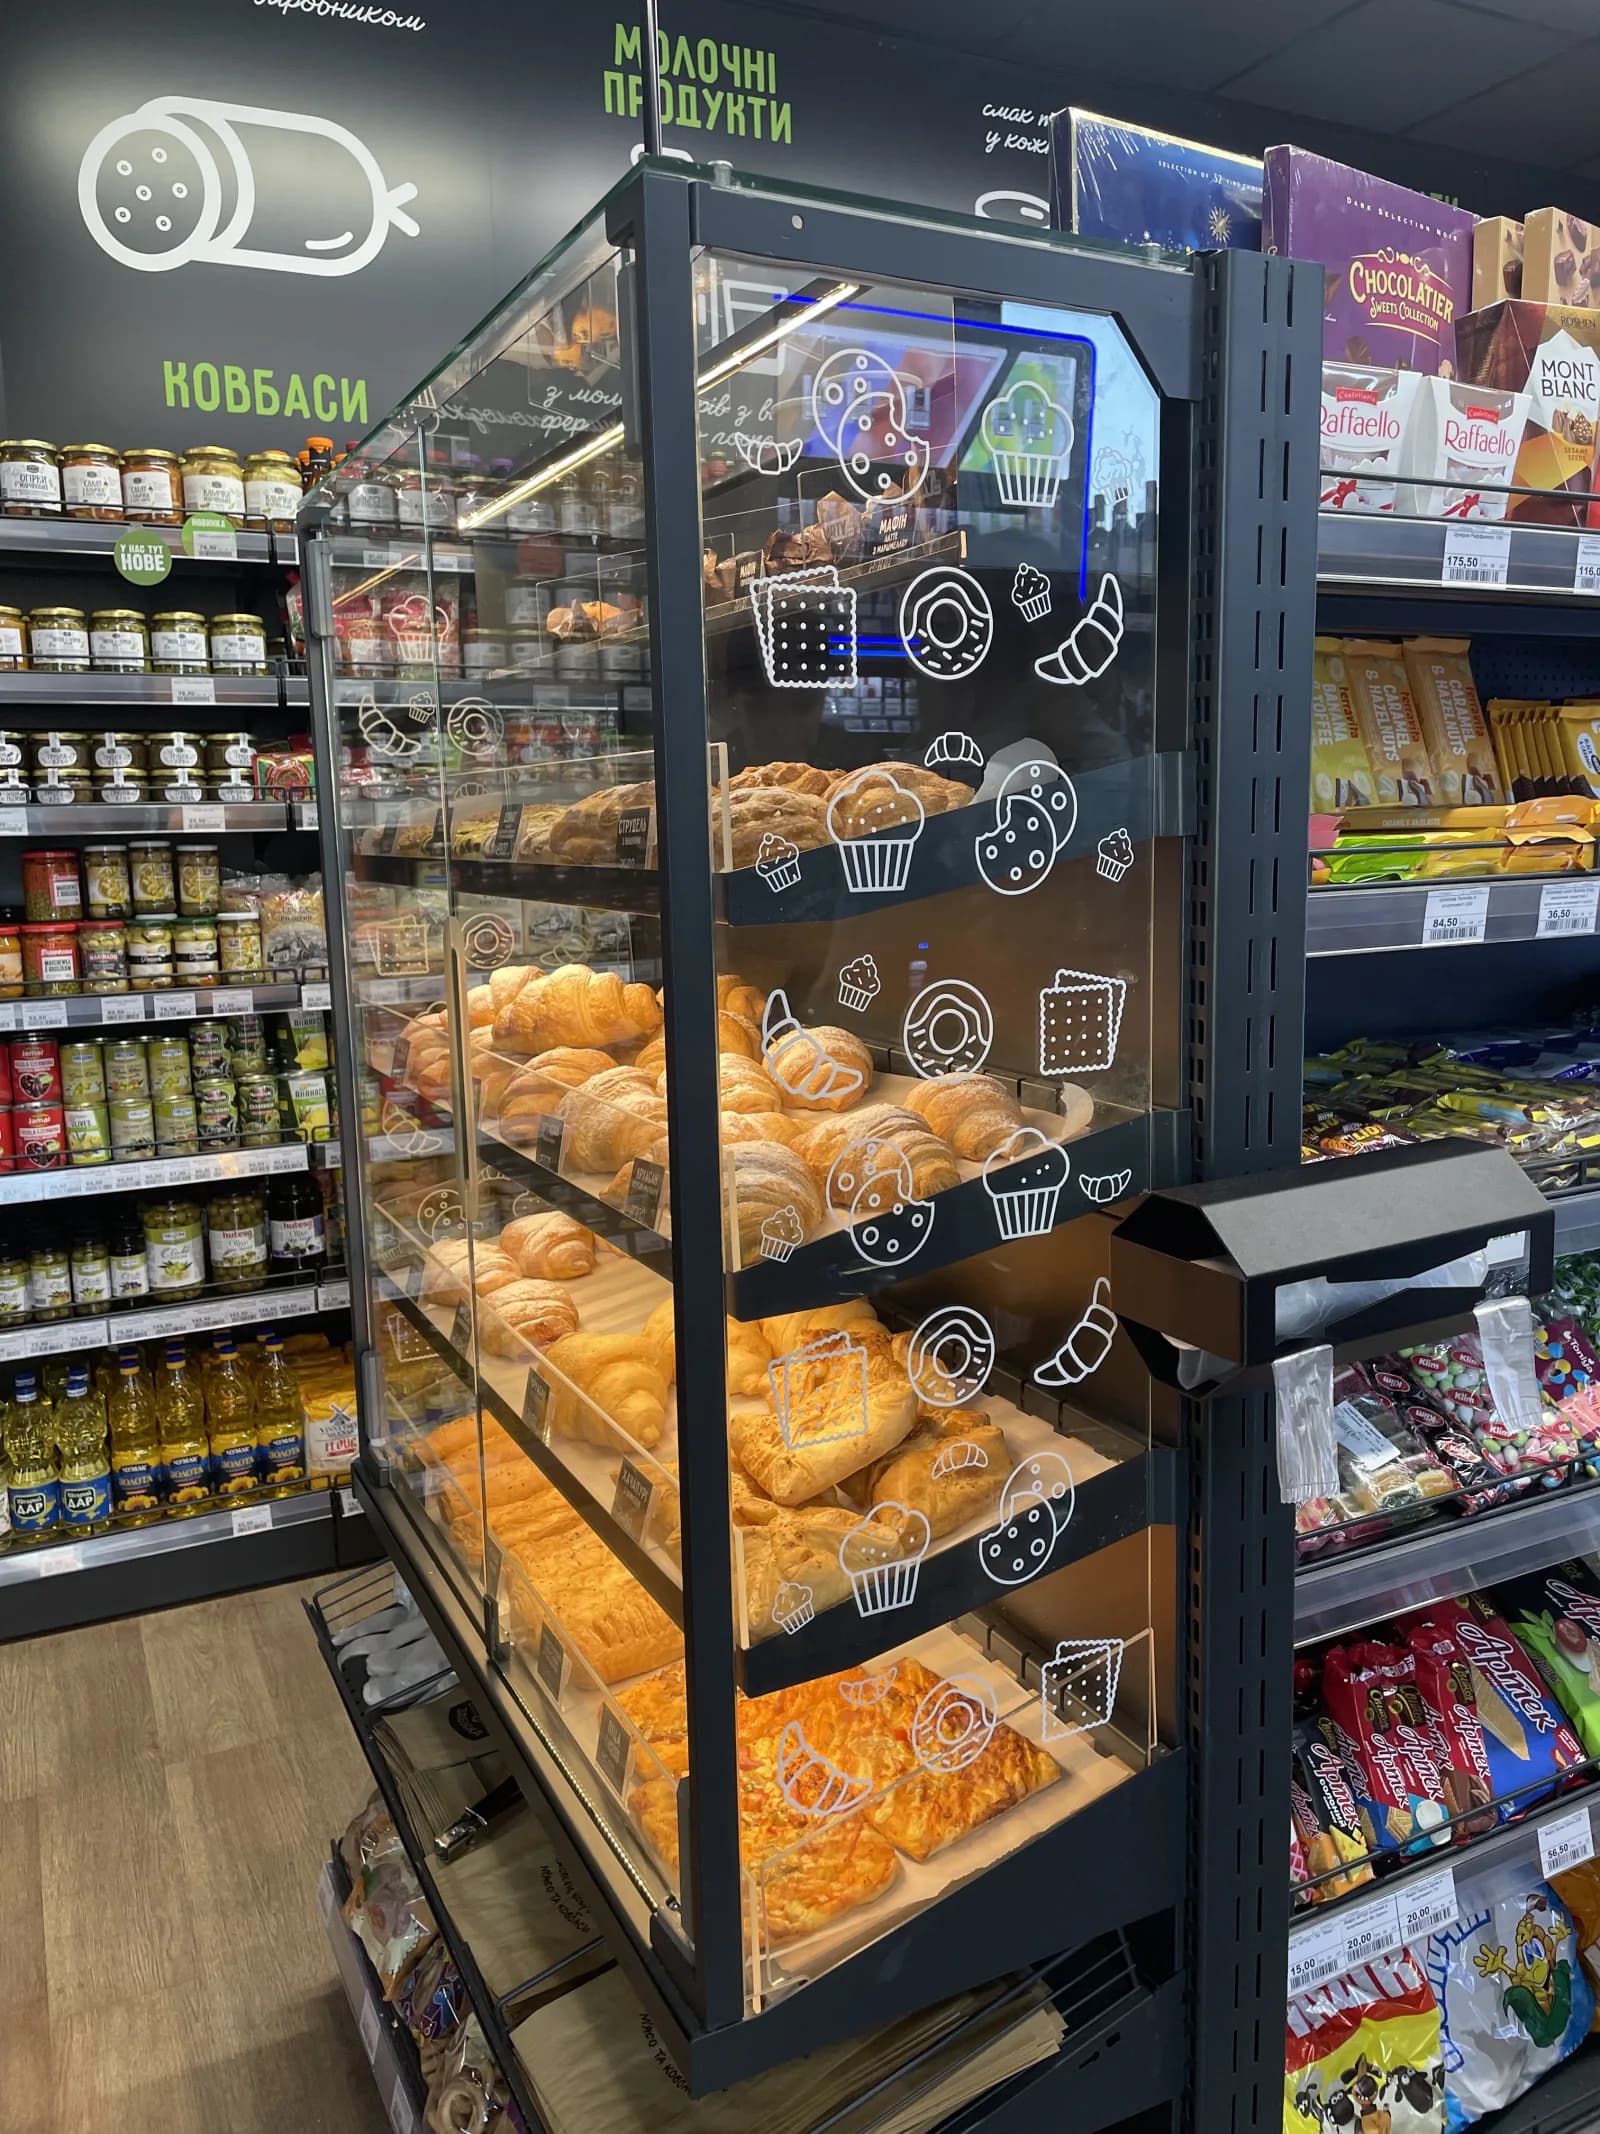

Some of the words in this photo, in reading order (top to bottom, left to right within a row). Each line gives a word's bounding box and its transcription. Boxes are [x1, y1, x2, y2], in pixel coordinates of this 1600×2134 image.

[254, 0, 426, 31] иробником
[614, 23, 776, 94] МОЛОЧНІ
[603, 71, 792, 144] ПРОДУКТИ
[982, 104, 1035, 123] смак
[1004, 136, 1049, 155] кож
[1213, 172, 1222, 185] 52
[1346, 196, 1372, 211] DARK
[1378, 208, 1431, 232] SELECTION
[1349, 260, 1454, 324] CHOCOLATIER
[1369, 296, 1398, 319] SWEETS
[1399, 301, 1440, 332] COLLECTION
[1541, 359, 1594, 381] MONT
[162, 359, 369, 425] КОВБАСИ
[1541, 379, 1597, 401] BLANC
[1444, 420, 1516, 457] Raffaello
[879, 513, 908, 534] МАФІН
[121, 554, 166, 572] НОВЕ
[1447, 556, 1478, 569] 175,50
[1322, 683, 1349, 742] BANANA
[1338, 686, 1360, 739] terravita
[1368, 684, 1400, 762] HAZELNUTS
[1383, 684, 1410, 748] CARAMEL
[1434, 679, 1467, 756] HAZELNUTS
[1449, 679, 1476, 742] CARAMEL
[1433, 917, 1458, 929] 84,50
[1548, 908, 1571, 920] 36,50
[1418, 1358, 1440, 1370] Klim
[1568, 1337, 1594, 1374] Toniya
[1382, 1376, 1403, 1388] Klim
[1454, 1391, 1475, 1404] Klim
[1415, 1409, 1437, 1424] Klim
[16, 1502, 43, 1515] ДАР
[66, 1496, 94, 1509] ДАР
[1455, 1622, 1558, 1734] Артек
[1453, 1703, 1491, 1778] Артек
[1371, 1733, 1410, 1809] Артек
[1397, 1725, 1445, 1801] Артек
[1311, 1743, 1361, 1830] Артек
[1547, 1843, 1569, 1859] 56,50
[1407, 1906, 1430, 1923] 20,00
[1347, 1932, 1372, 1950] 20,00
[1290, 1958, 1316, 1976] 15,00
[639, 2012, 658, 2049] М'ЯСО
[654, 2047, 668, 2070] ТА
